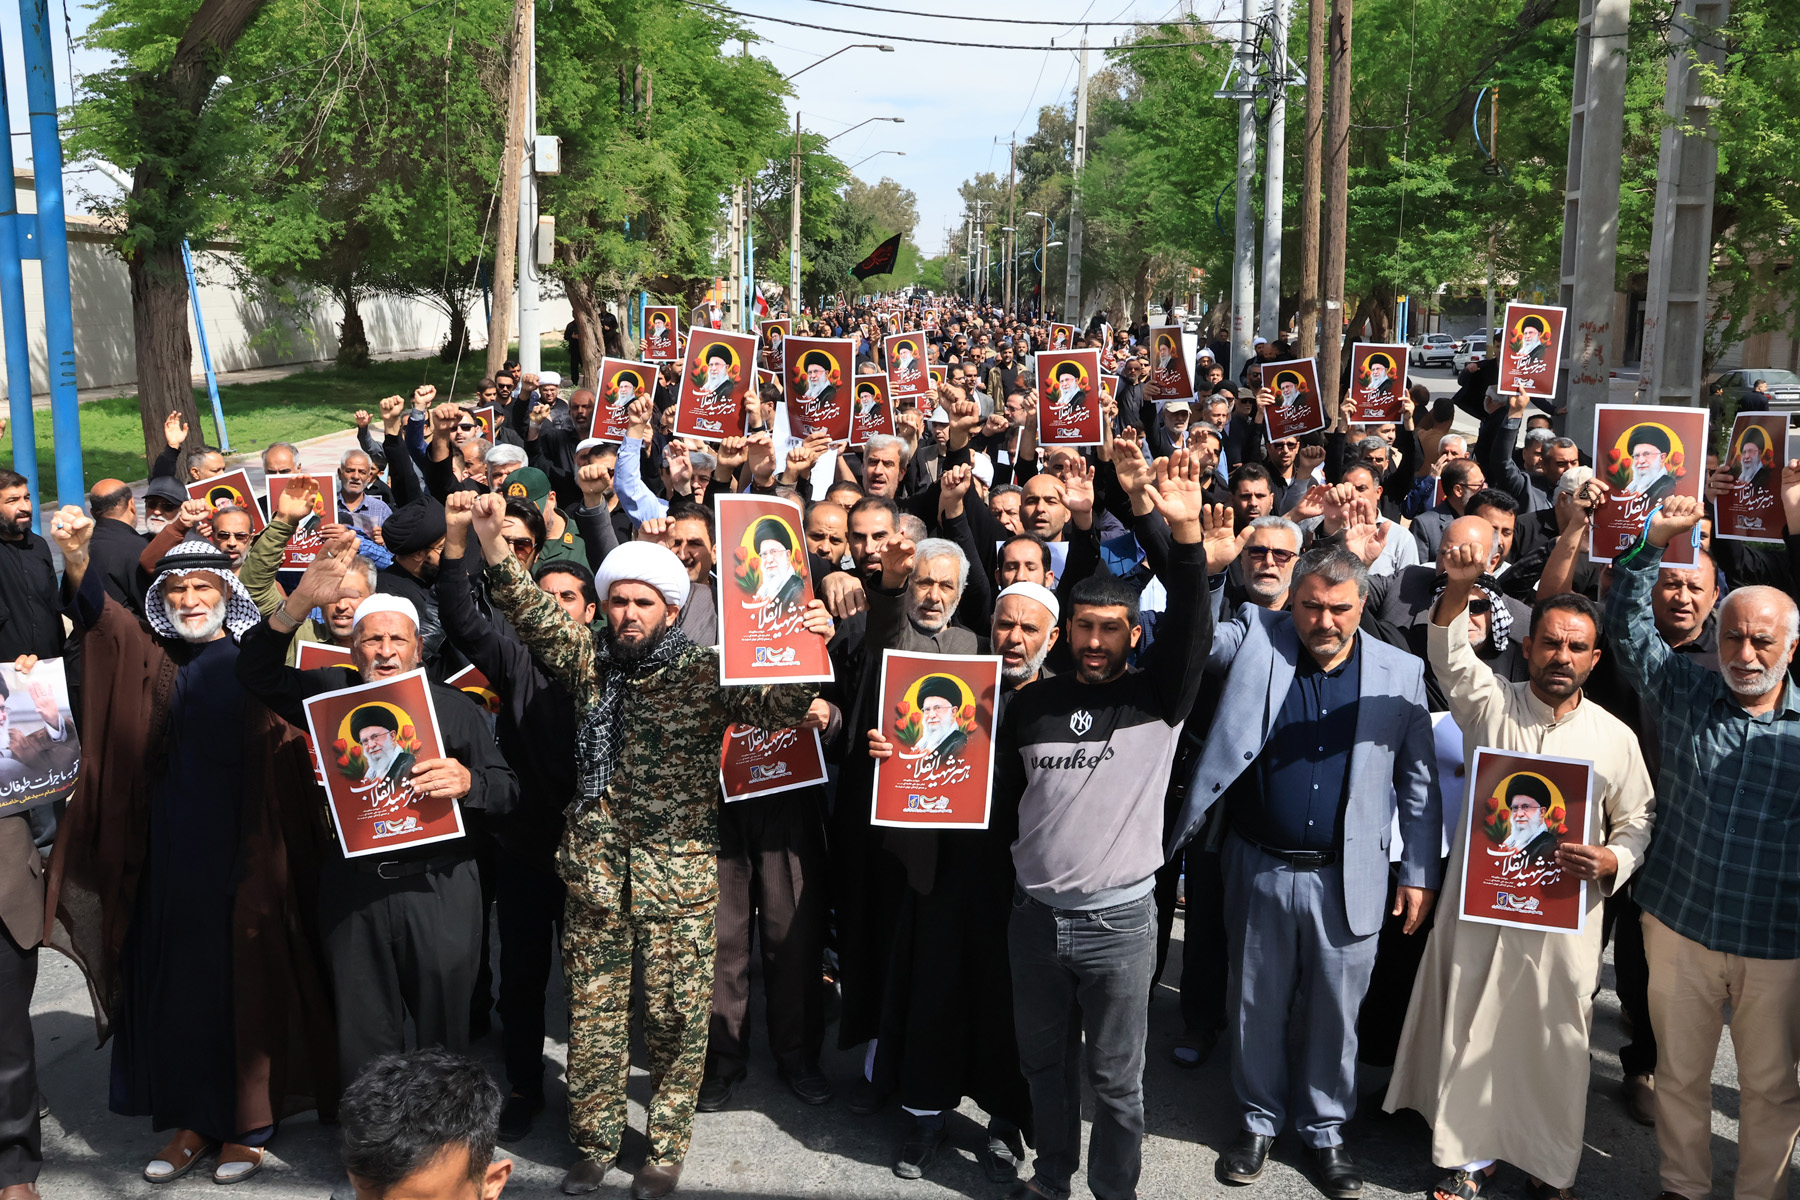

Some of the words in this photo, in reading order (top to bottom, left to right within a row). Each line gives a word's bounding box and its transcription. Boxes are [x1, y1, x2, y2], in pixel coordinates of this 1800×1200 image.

[1611, 490, 1650, 519] انقلاب
[742, 596, 783, 630] انقلاب
[767, 602, 798, 639] شهید
[899, 747, 942, 779] انقلاب
[922, 755, 957, 788] شهید
[941, 759, 971, 786] رهبر
[350, 776, 396, 807] انقلاب
[383, 777, 415, 812] شهید
[1486, 844, 1530, 876] انقلاب
[1511, 856, 1546, 887] شهید
[1530, 862, 1562, 887] رهبر
